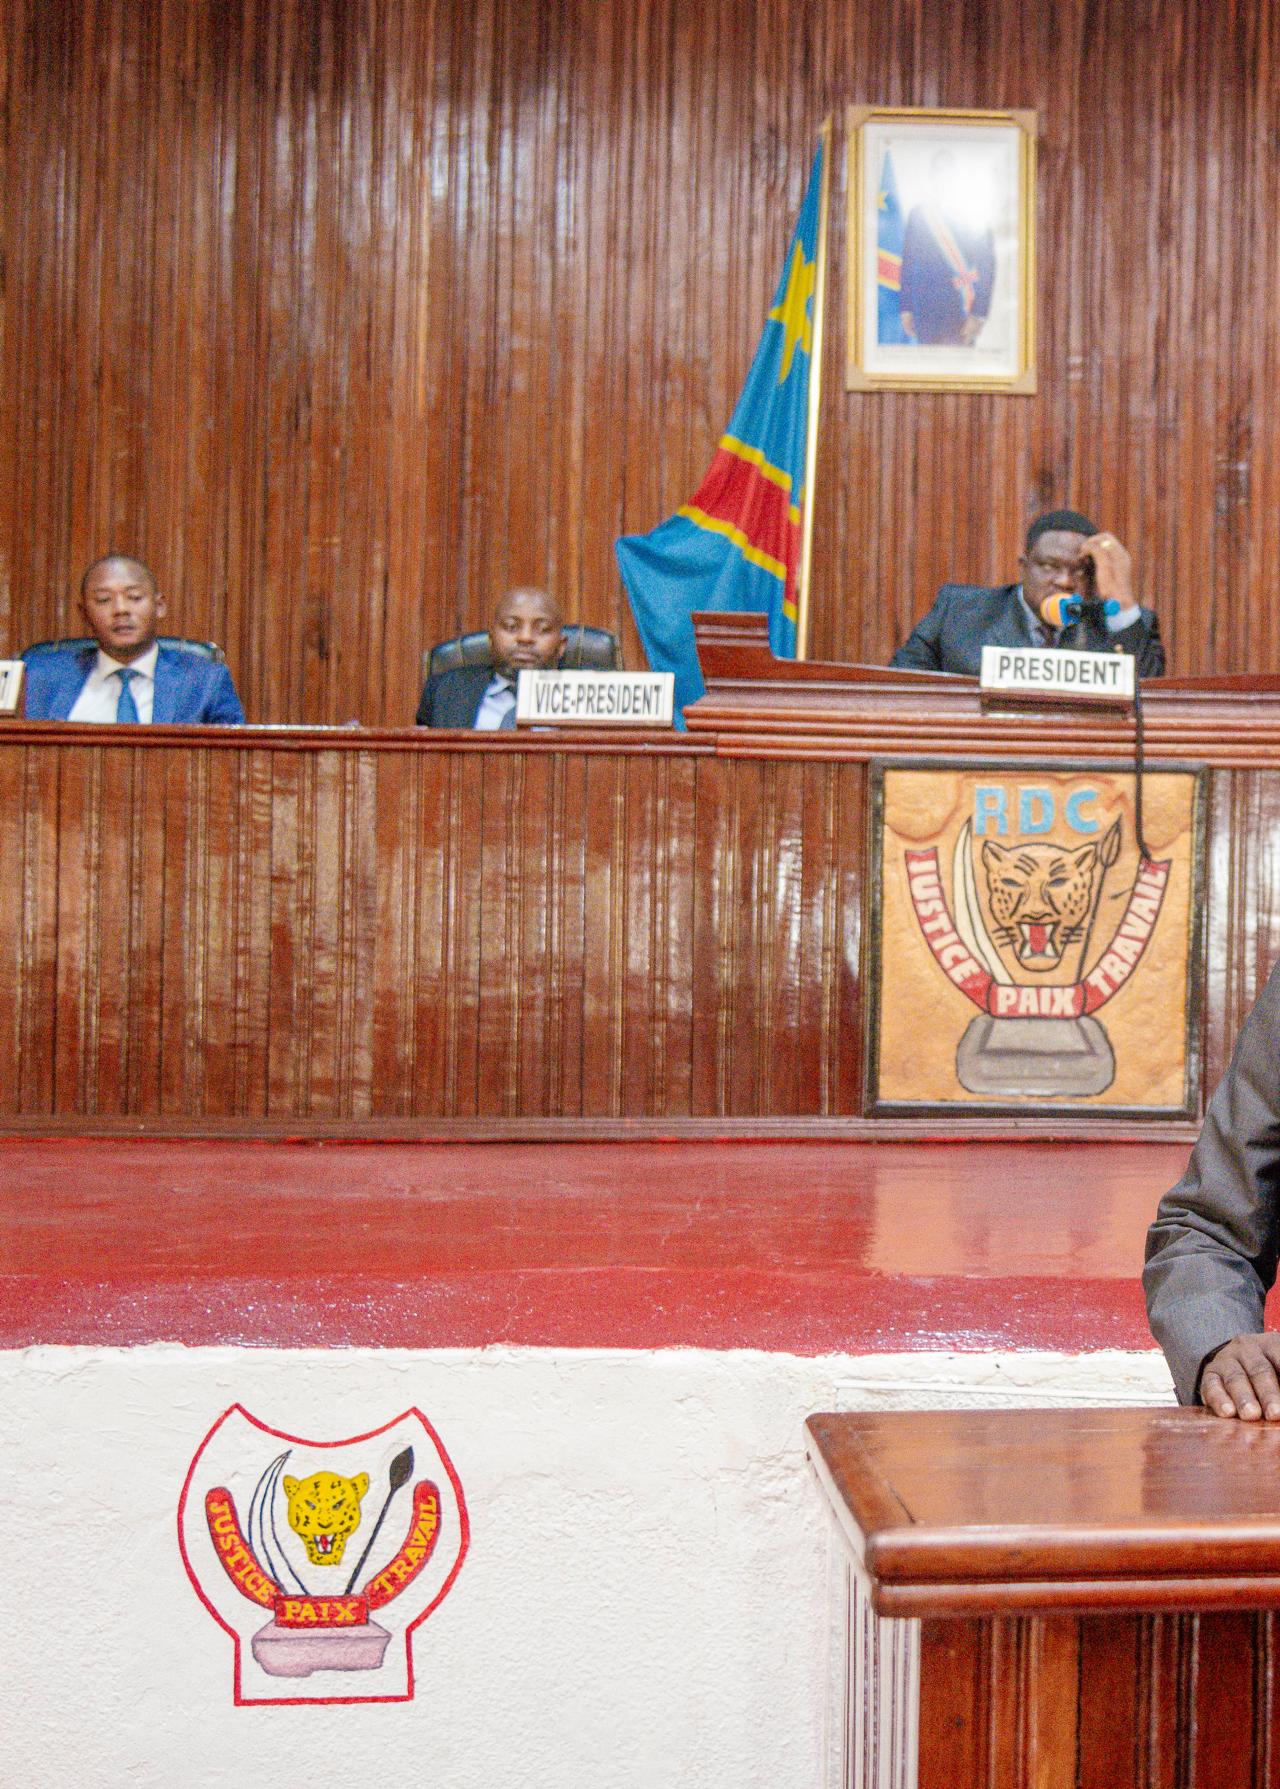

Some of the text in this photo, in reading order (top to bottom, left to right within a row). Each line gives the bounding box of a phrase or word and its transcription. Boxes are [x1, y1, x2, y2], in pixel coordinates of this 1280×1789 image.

[998, 655, 1121, 685] PRESIDENT
[535, 683, 662, 715] VICE-PRESIDENT
[974, 785, 1100, 836] RDC
[996, 987, 1075, 1015] PAIX
[1086, 869, 1168, 996] TRAVAIL
[208, 1495, 439, 1621] JUSTICE PAIX TRAVAIL
